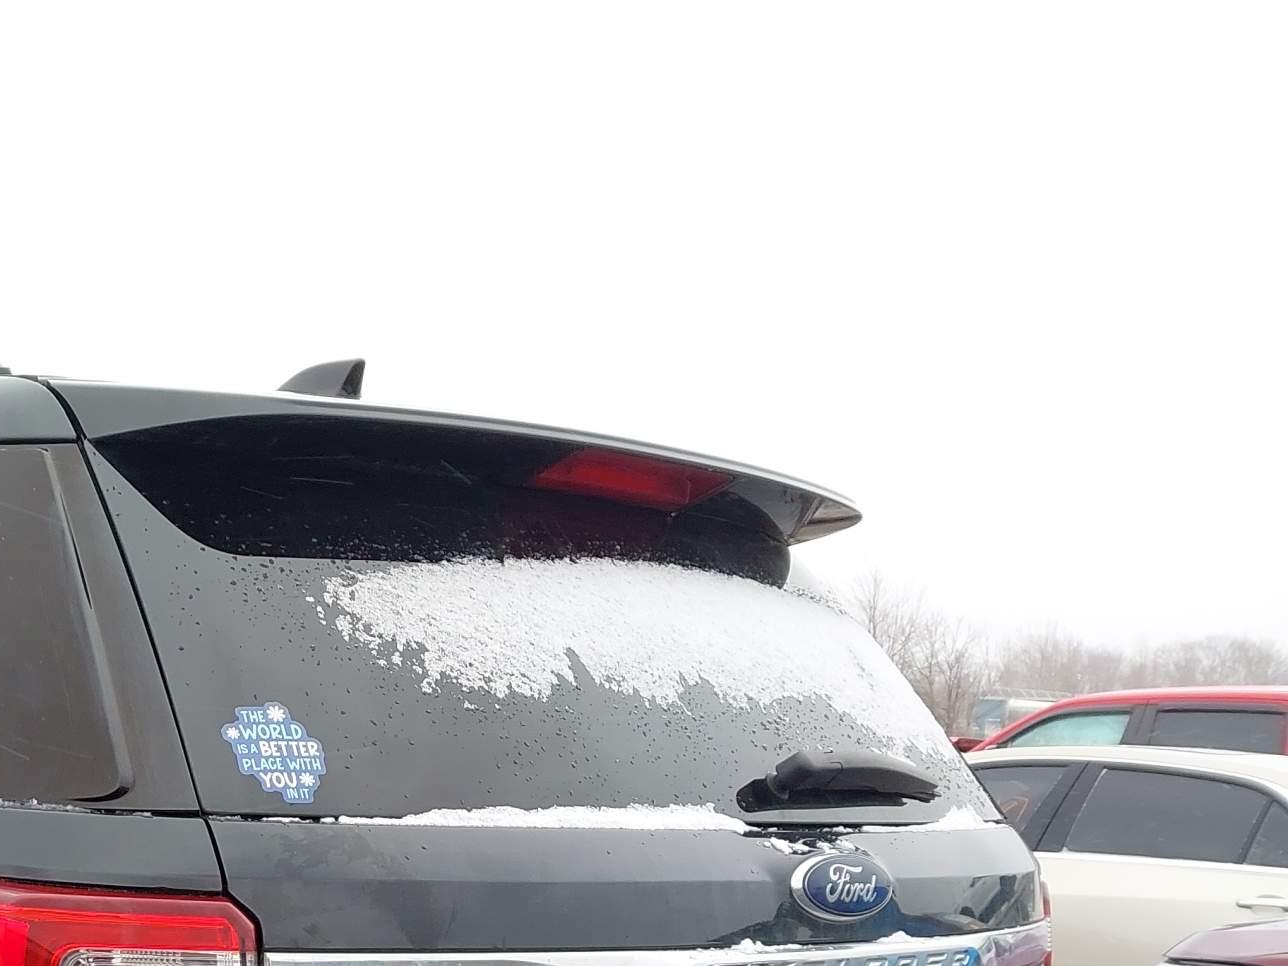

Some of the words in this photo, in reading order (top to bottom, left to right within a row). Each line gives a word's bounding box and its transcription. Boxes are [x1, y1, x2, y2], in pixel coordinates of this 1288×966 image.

[240, 710, 265, 722] THE
[239, 724, 302, 739] WORLD
[237, 743, 249, 754] IS
[250, 743, 258, 754] A
[259, 740, 320, 757] BETTER
[242, 757, 284, 771] PLACE
[286, 757, 321, 771] WITH
[260, 772, 297, 788] YOU
[286, 788, 299, 799] IN
[299, 788, 310, 800] IT
[825, 863, 878, 904] Ford
